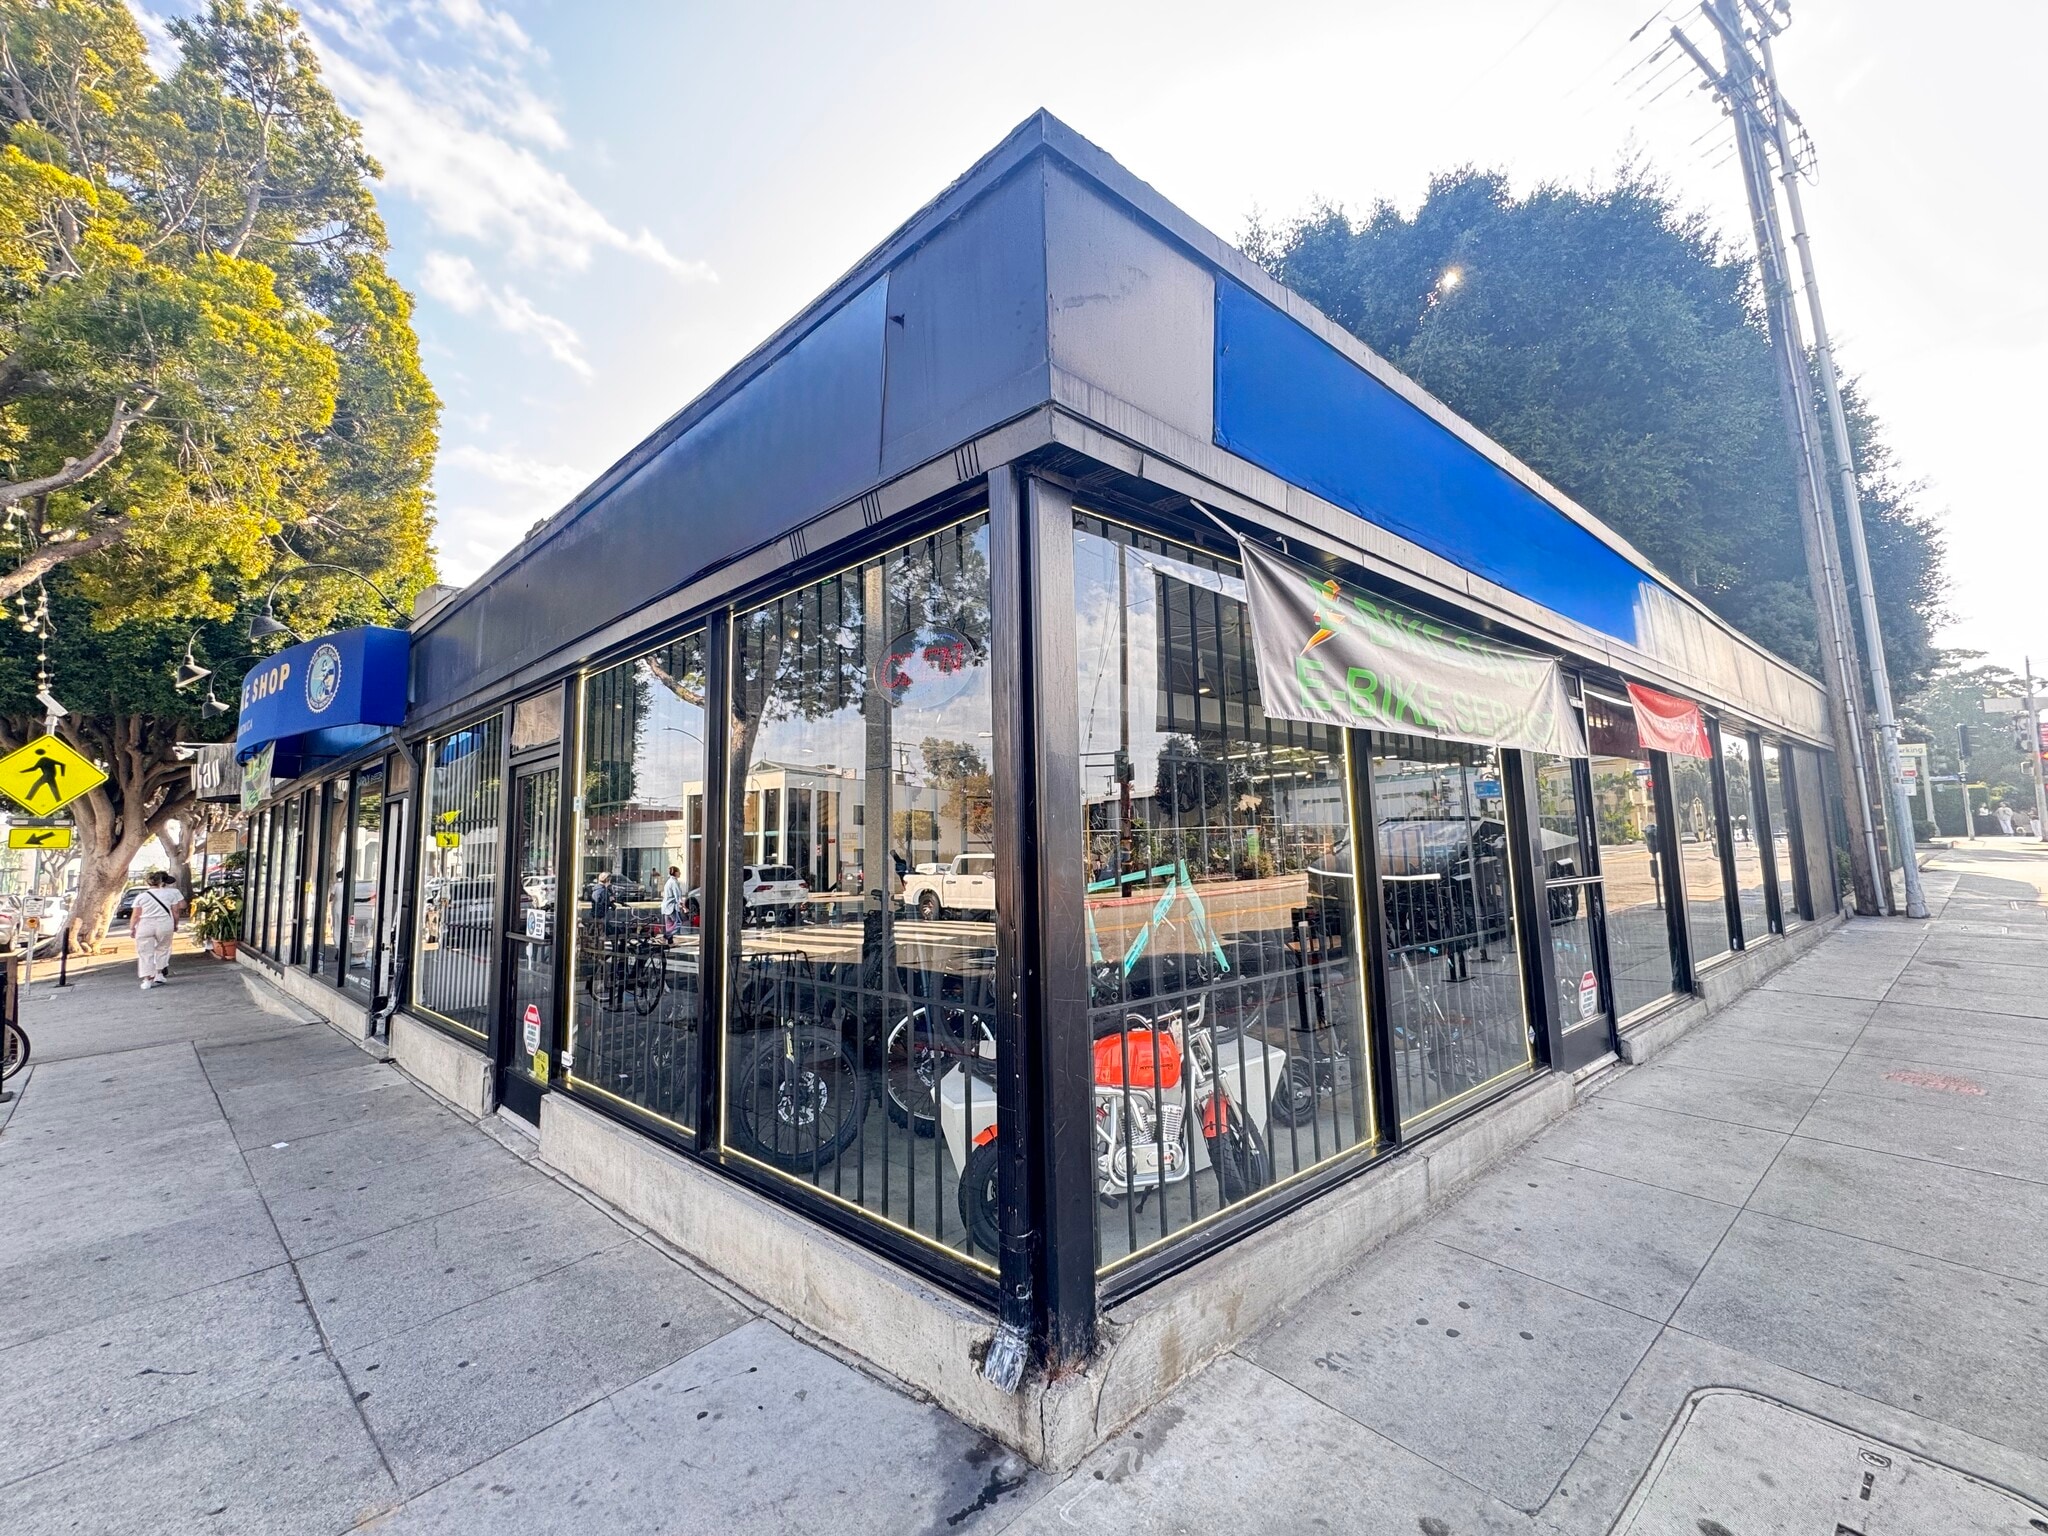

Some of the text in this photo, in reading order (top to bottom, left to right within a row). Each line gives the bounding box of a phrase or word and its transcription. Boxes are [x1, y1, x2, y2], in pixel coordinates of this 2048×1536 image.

[252, 662, 291, 704] SHOP
[1296, 656, 1449, 728] E-BIKE
[1898, 746, 1924, 754] arking
